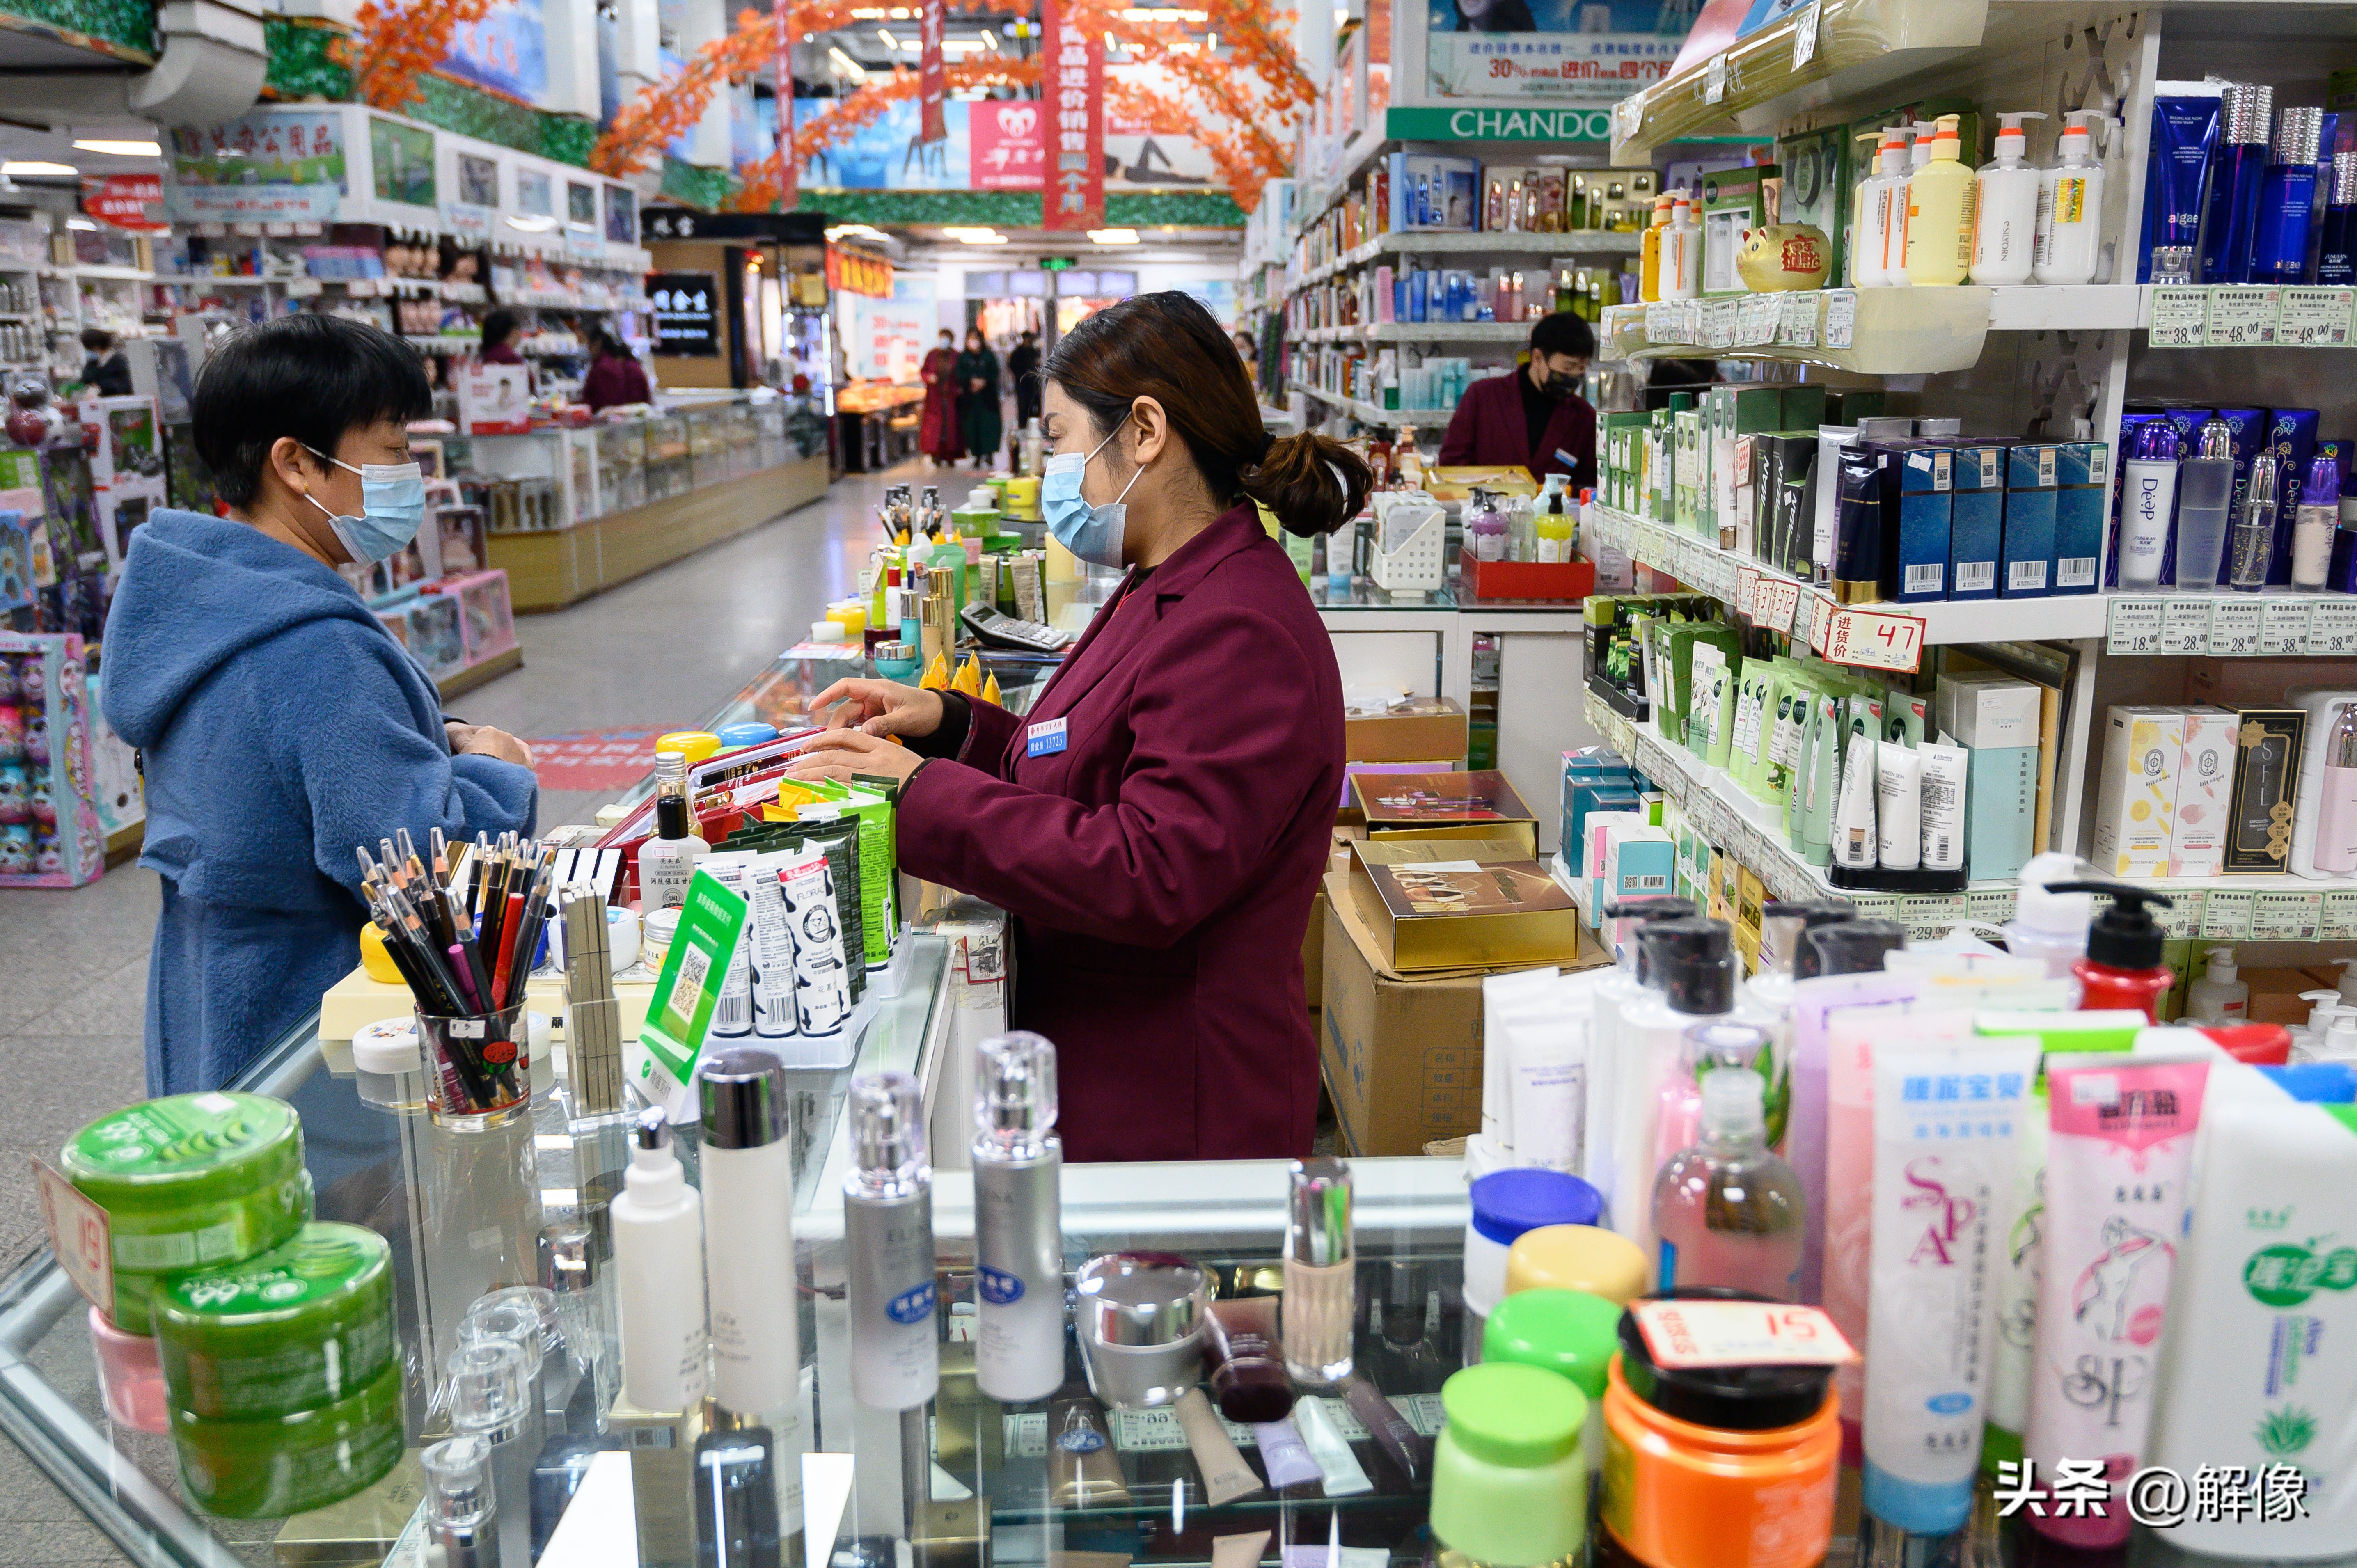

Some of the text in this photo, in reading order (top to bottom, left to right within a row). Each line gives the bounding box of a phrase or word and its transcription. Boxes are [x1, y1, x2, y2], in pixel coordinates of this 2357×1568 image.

[1450, 111, 1610, 137] CHANDO
[2168, 213, 2198, 225] algae
[1998, 227, 2009, 262] SILYORN
[1833, 616, 1852, 658] 进货价
[1877, 624, 1915, 650] 47
[1046, 735, 1063, 749] 13723
[2018, 752, 2028, 814] 氨基酸洁面慕斯
[797, 886, 825, 901] FLORAL
[1435, 1053, 1455, 1063] 名称
